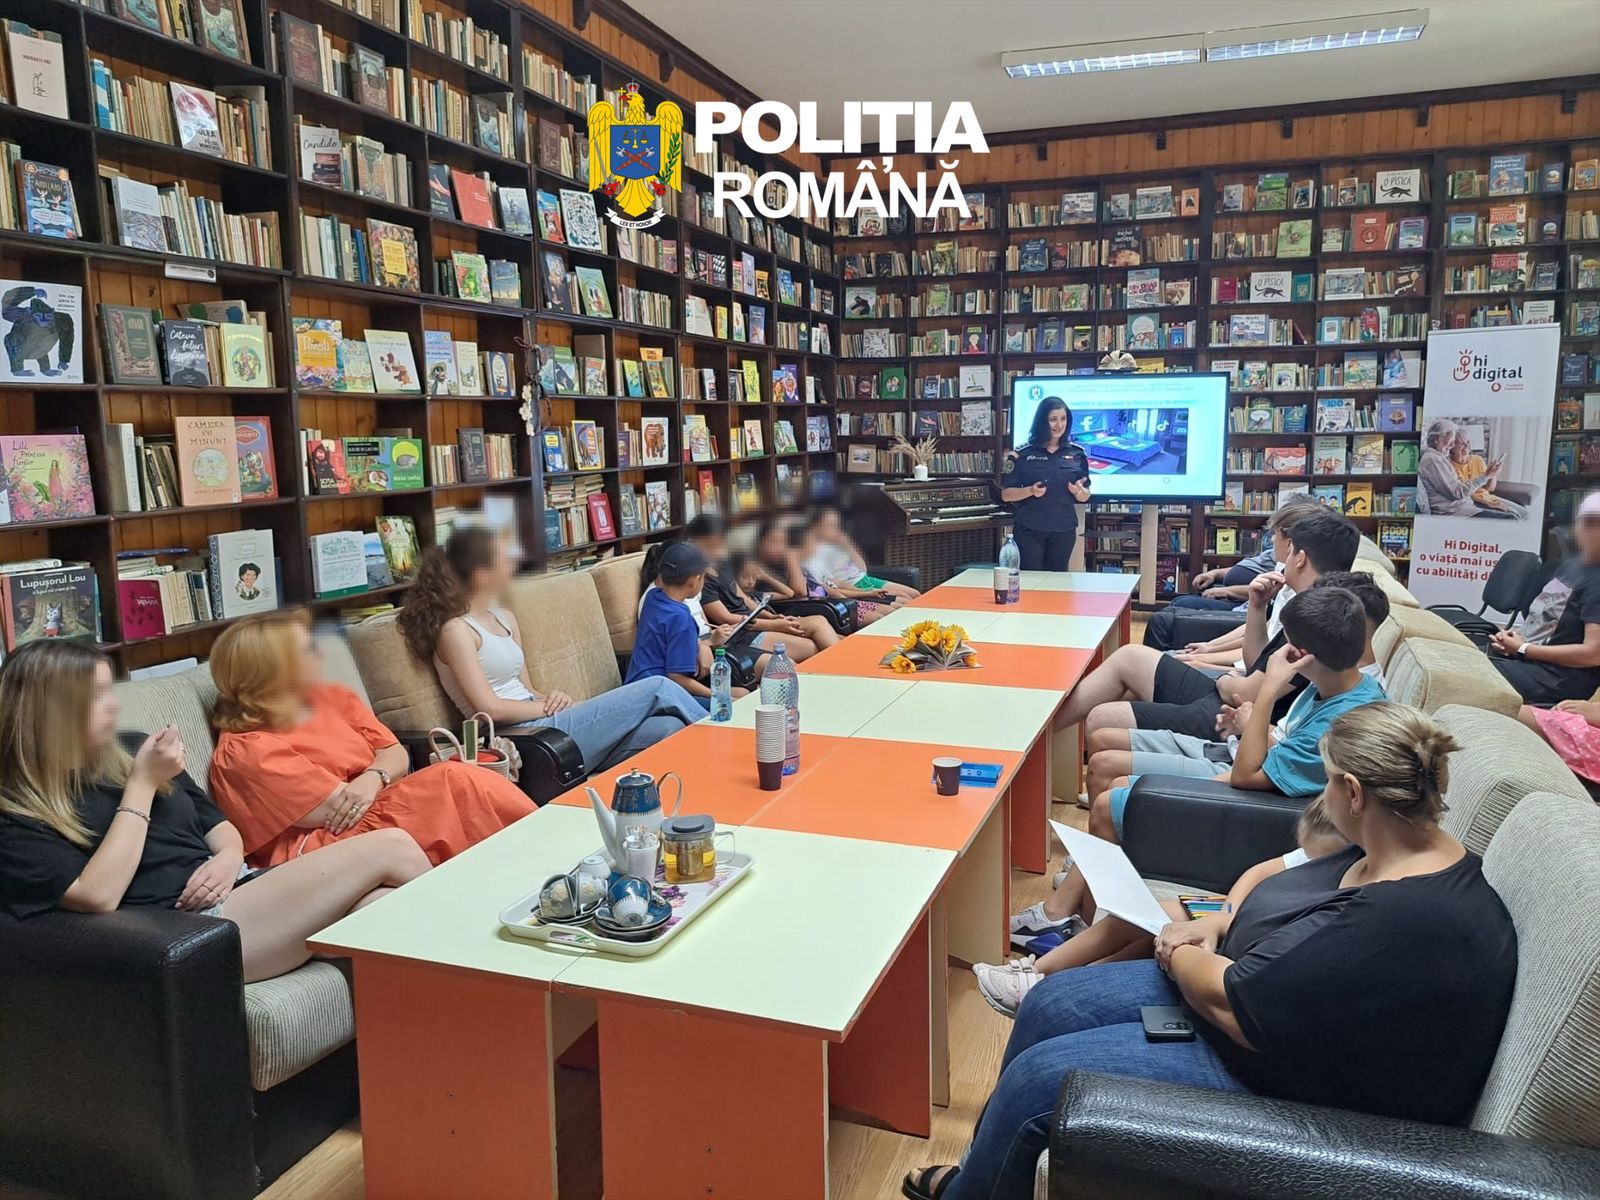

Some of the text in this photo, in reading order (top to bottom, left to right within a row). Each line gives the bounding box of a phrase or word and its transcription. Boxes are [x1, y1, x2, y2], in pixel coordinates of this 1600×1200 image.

[1473, 354, 1488, 367] hi
[1472, 366, 1523, 383] digital
[187, 421, 226, 429] CAMERA
[190, 438, 227, 446] MINUNI
[1382, 526, 1409, 536] 5000
[1444, 540, 1502, 554] Hi Digital,
[1420, 553, 1426, 561] o
[1429, 552, 1458, 566] viață
[1460, 556, 1482, 566] mai
[1416, 567, 1429, 575] cu
[1431, 567, 1478, 582] abilități
[20, 574, 86, 590] Lupușorul Lou
